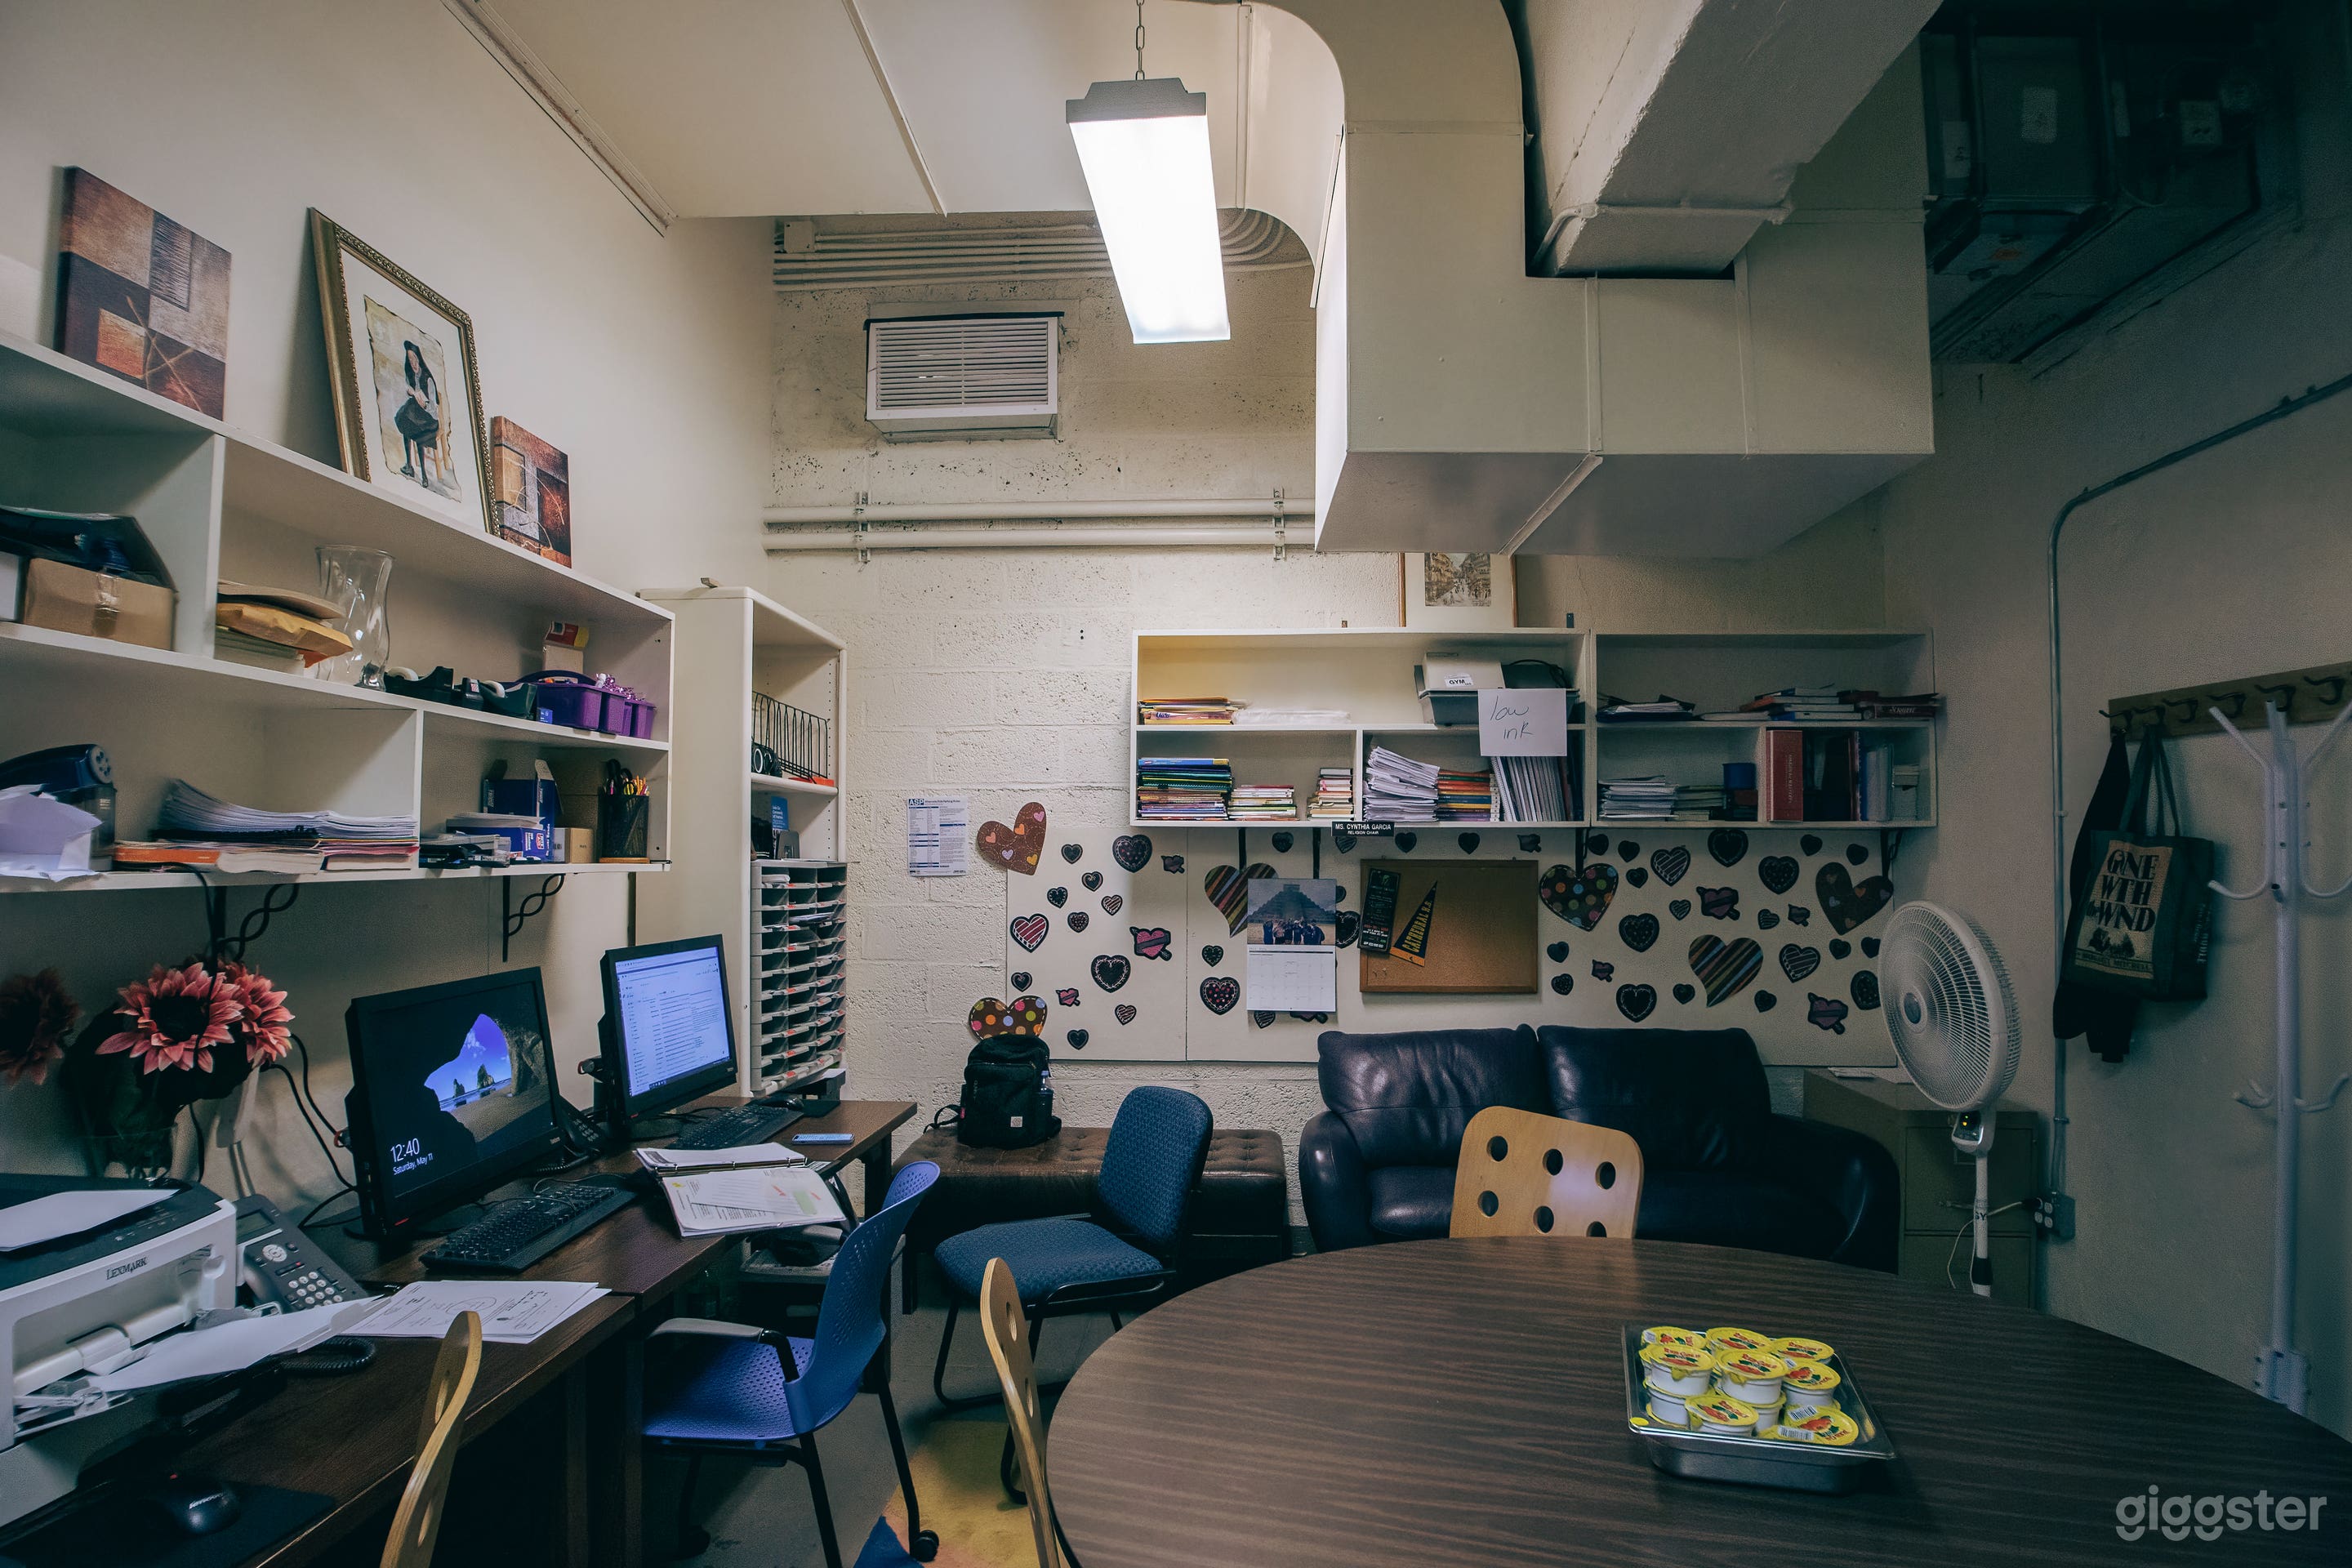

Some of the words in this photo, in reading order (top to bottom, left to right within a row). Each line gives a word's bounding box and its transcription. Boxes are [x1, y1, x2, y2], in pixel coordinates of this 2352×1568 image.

[1490, 696, 1529, 721] low
[1402, 913, 1429, 952] CATHEDRAL
[390, 1138, 420, 1162] 12:40
[393, 1161, 416, 1175] Saturday,
[416, 1156, 427, 1165] May
[428, 1152, 434, 1160] 11
[107, 1257, 147, 1280] LEXMARK
